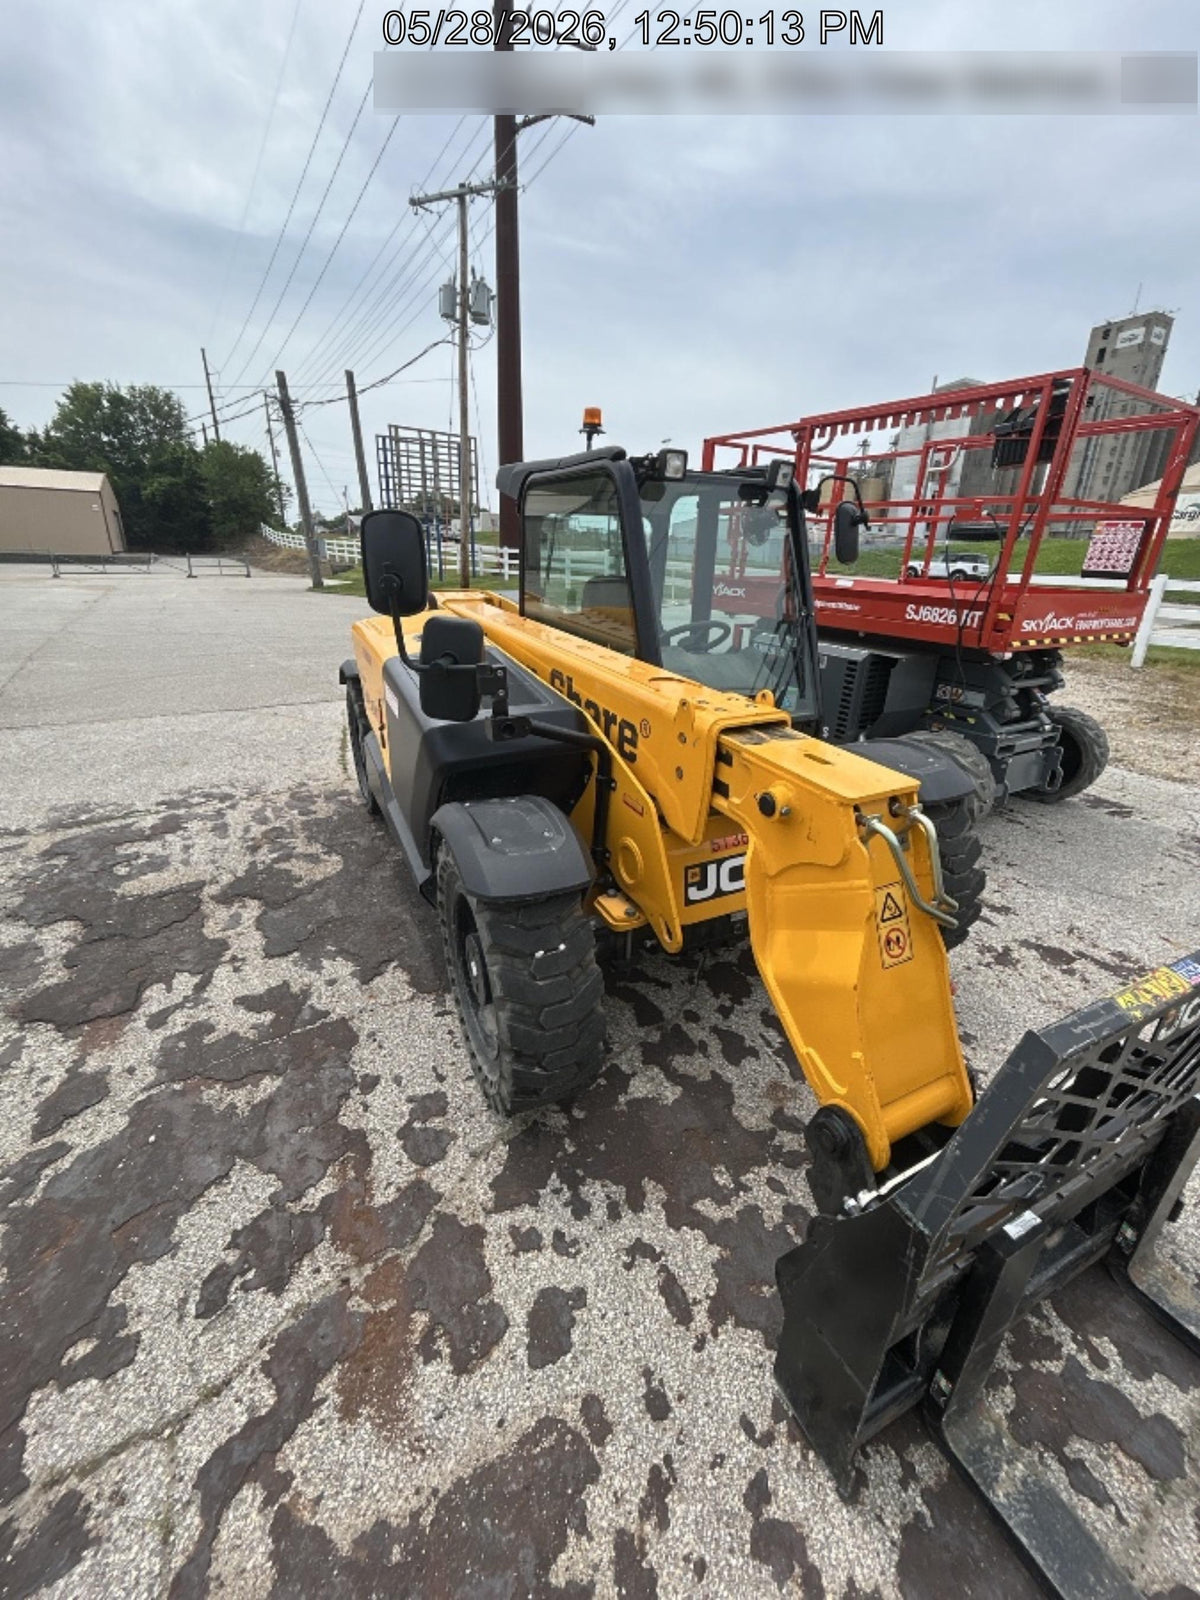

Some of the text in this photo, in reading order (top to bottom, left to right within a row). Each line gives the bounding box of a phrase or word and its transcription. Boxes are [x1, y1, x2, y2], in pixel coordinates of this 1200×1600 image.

[712, 582, 746, 598] YJACK
[905, 604, 957, 625] SJ6826
[1020, 611, 1075, 634] SKYJACK
[687, 856, 746, 901] JC
